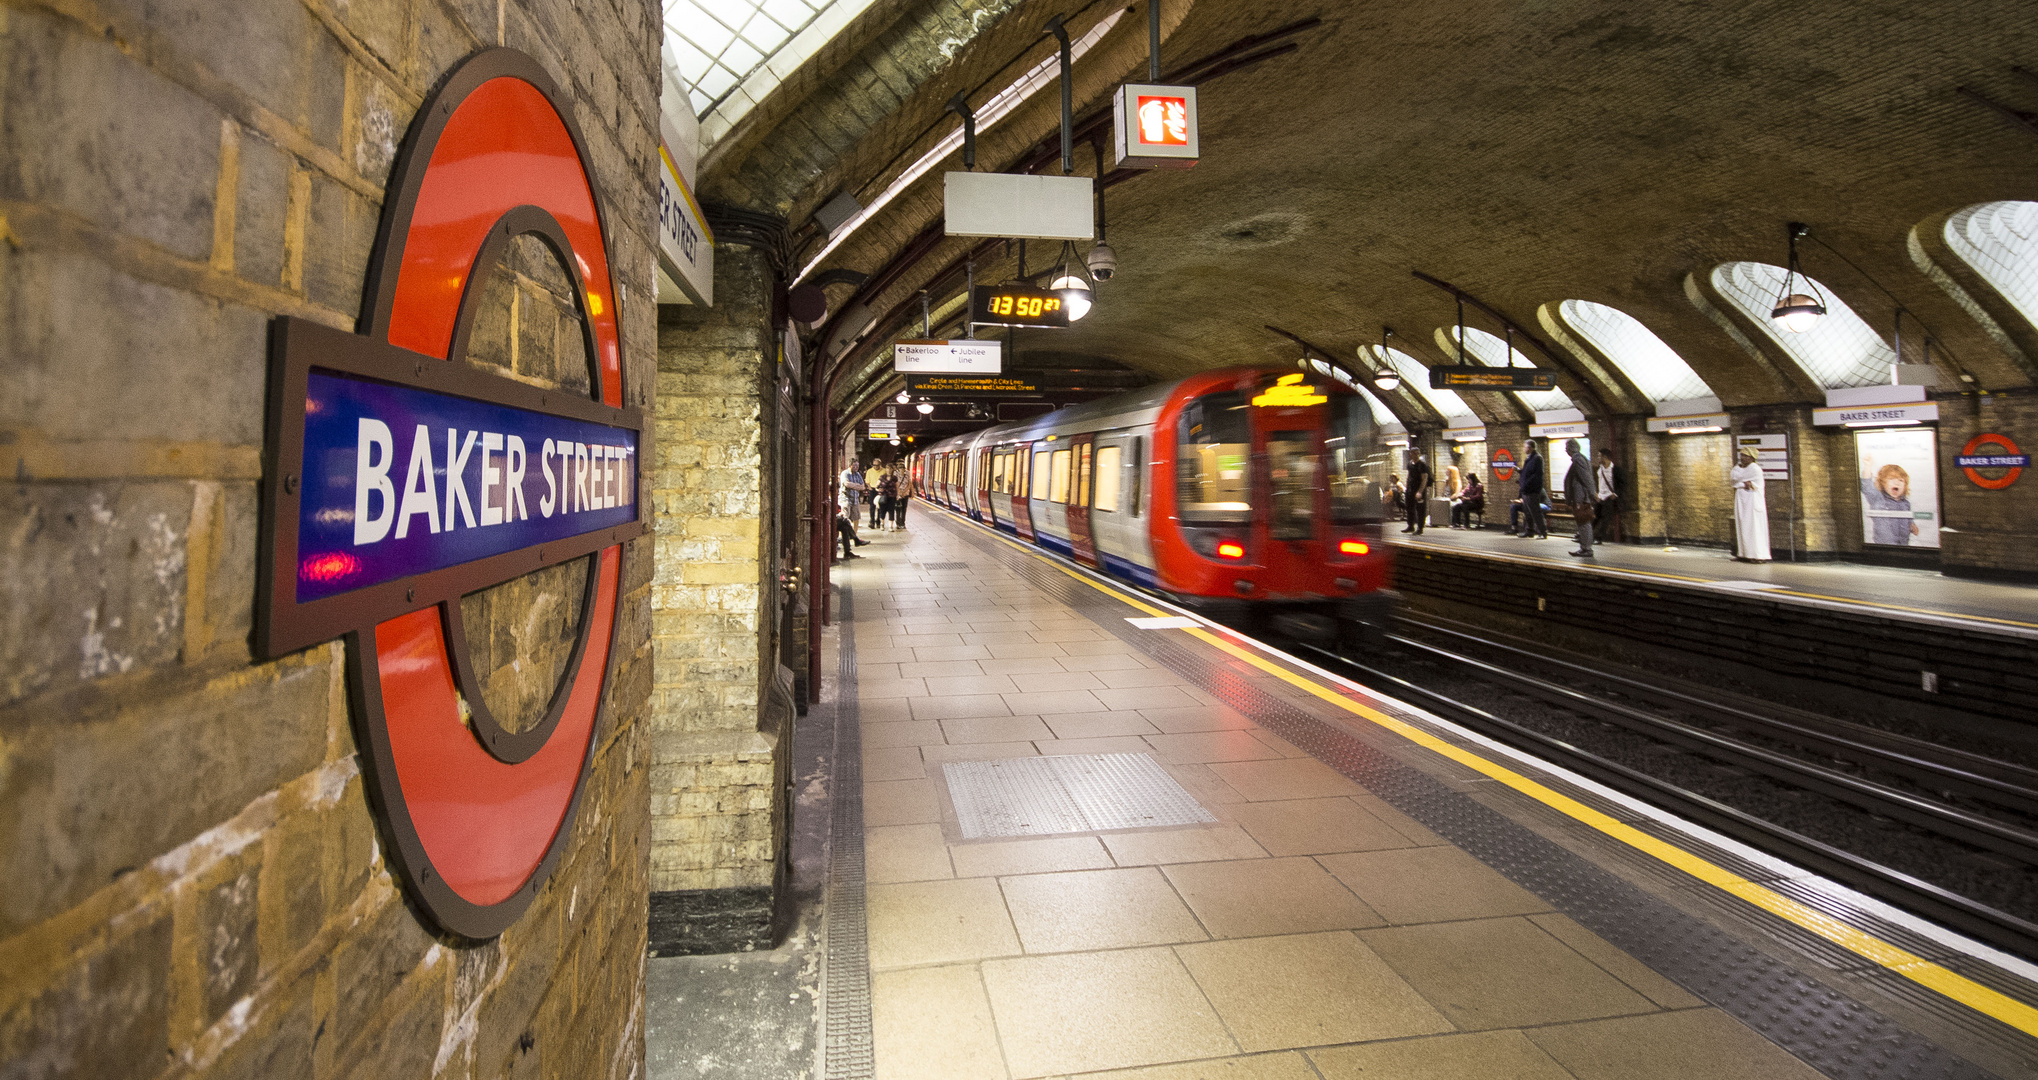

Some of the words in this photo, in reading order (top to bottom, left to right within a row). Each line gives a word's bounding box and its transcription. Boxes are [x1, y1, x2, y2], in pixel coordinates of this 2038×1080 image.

[671, 201, 698, 268] STREET
[959, 348, 986, 356] Jubilee
[905, 355, 920, 363] line
[958, 356, 973, 364] line
[1840, 411, 1869, 421] BAKER
[1871, 410, 1905, 420] STREET
[1665, 420, 1685, 428] BAKER
[1686, 419, 1710, 427] STREET
[1959, 457, 1989, 465] BAKER
[1990, 456, 2024, 465] STREET
[353, 417, 528, 546] BAKER
[539, 437, 627, 519] STREET
